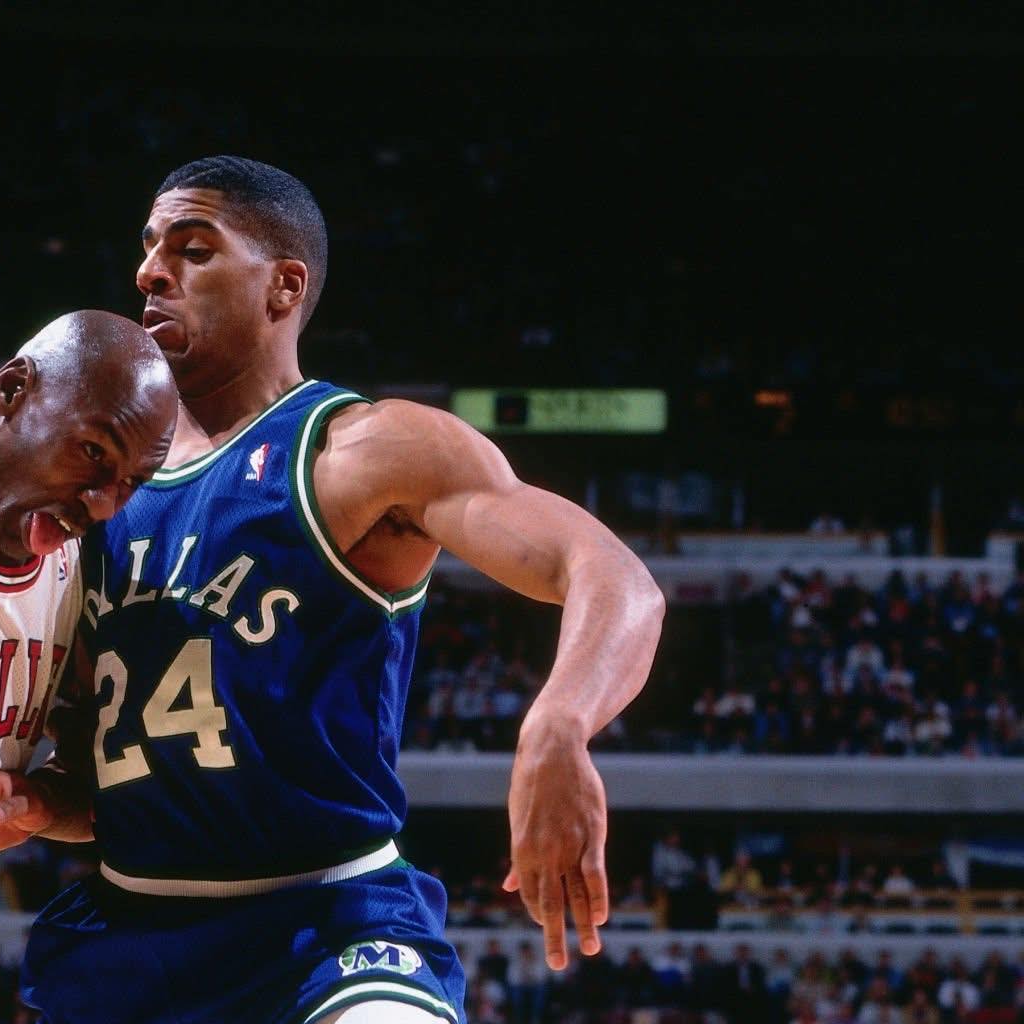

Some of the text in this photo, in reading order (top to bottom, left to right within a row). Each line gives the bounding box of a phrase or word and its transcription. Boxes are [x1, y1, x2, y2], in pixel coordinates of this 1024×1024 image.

[82, 535, 300, 644] LLAS
[93, 638, 237, 790] 24
[352, 944, 401, 970] M
